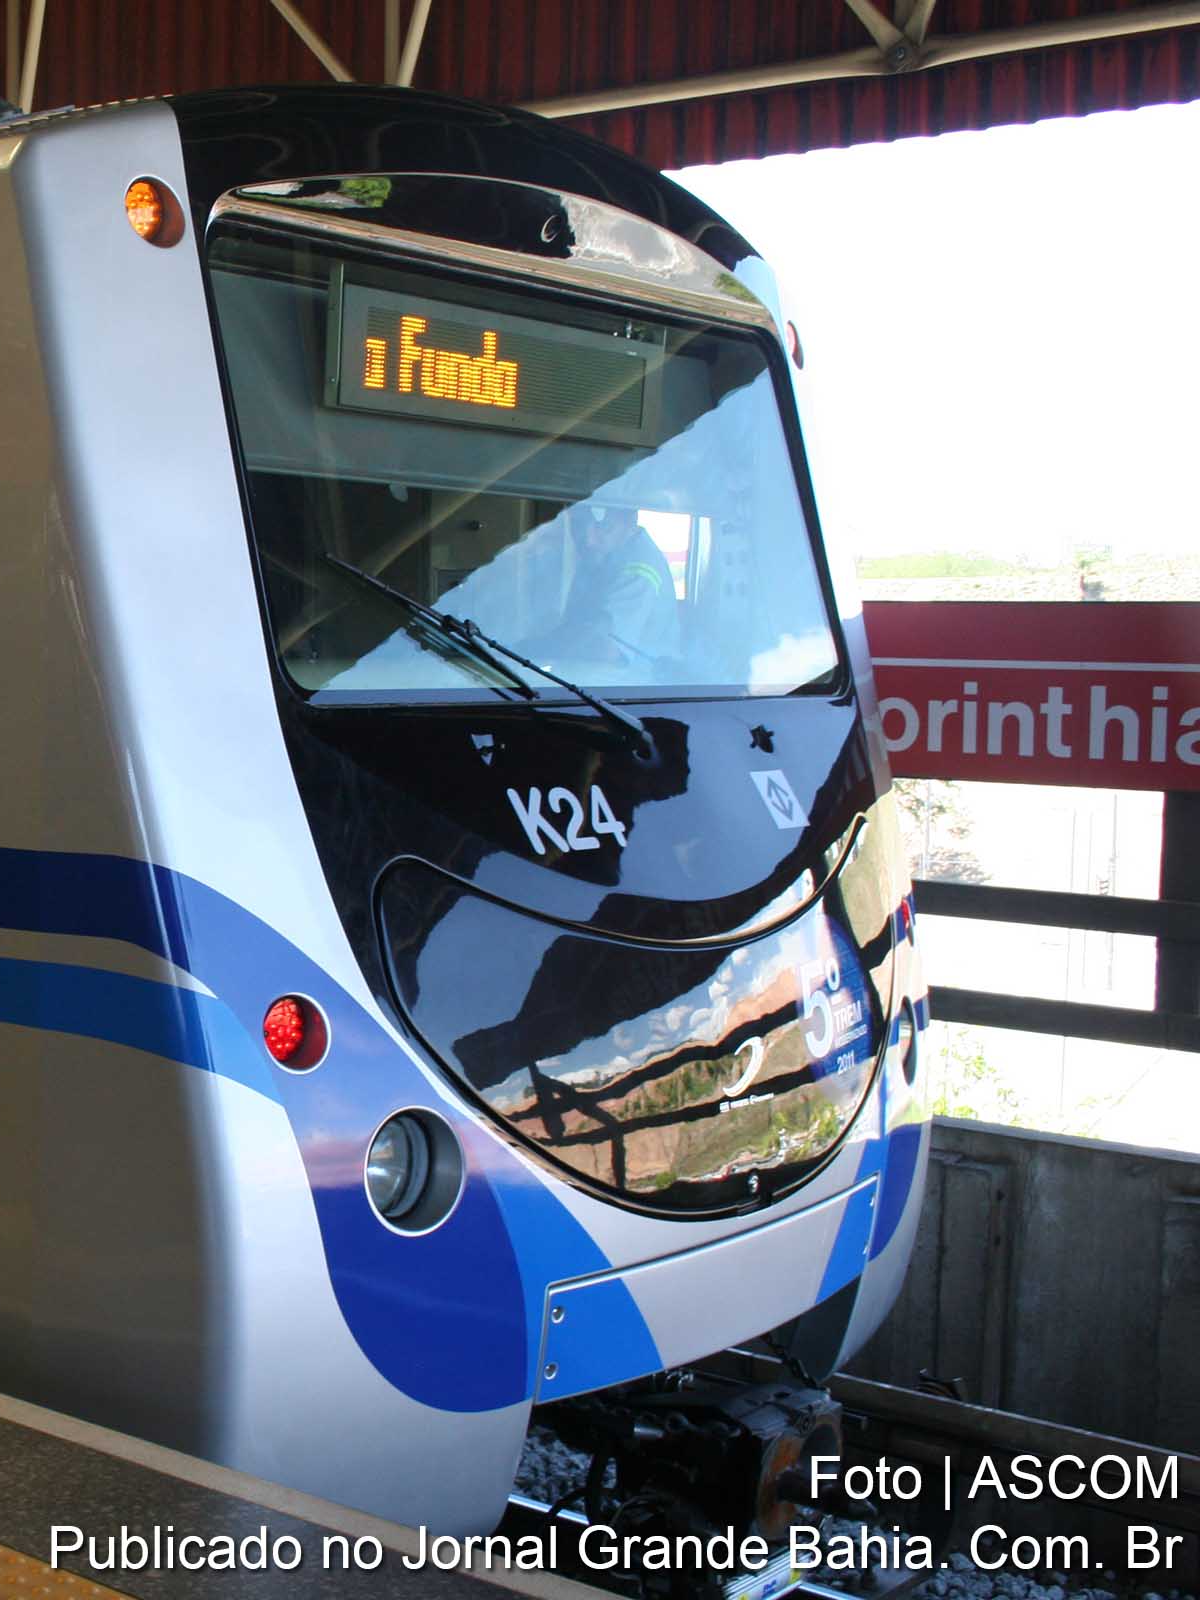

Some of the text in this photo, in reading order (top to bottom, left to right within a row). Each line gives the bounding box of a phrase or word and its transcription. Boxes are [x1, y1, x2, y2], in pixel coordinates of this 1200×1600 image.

[505, 784, 628, 856] K24
[834, 999, 863, 1034] TREM
[836, 1049, 856, 1076] 2011
